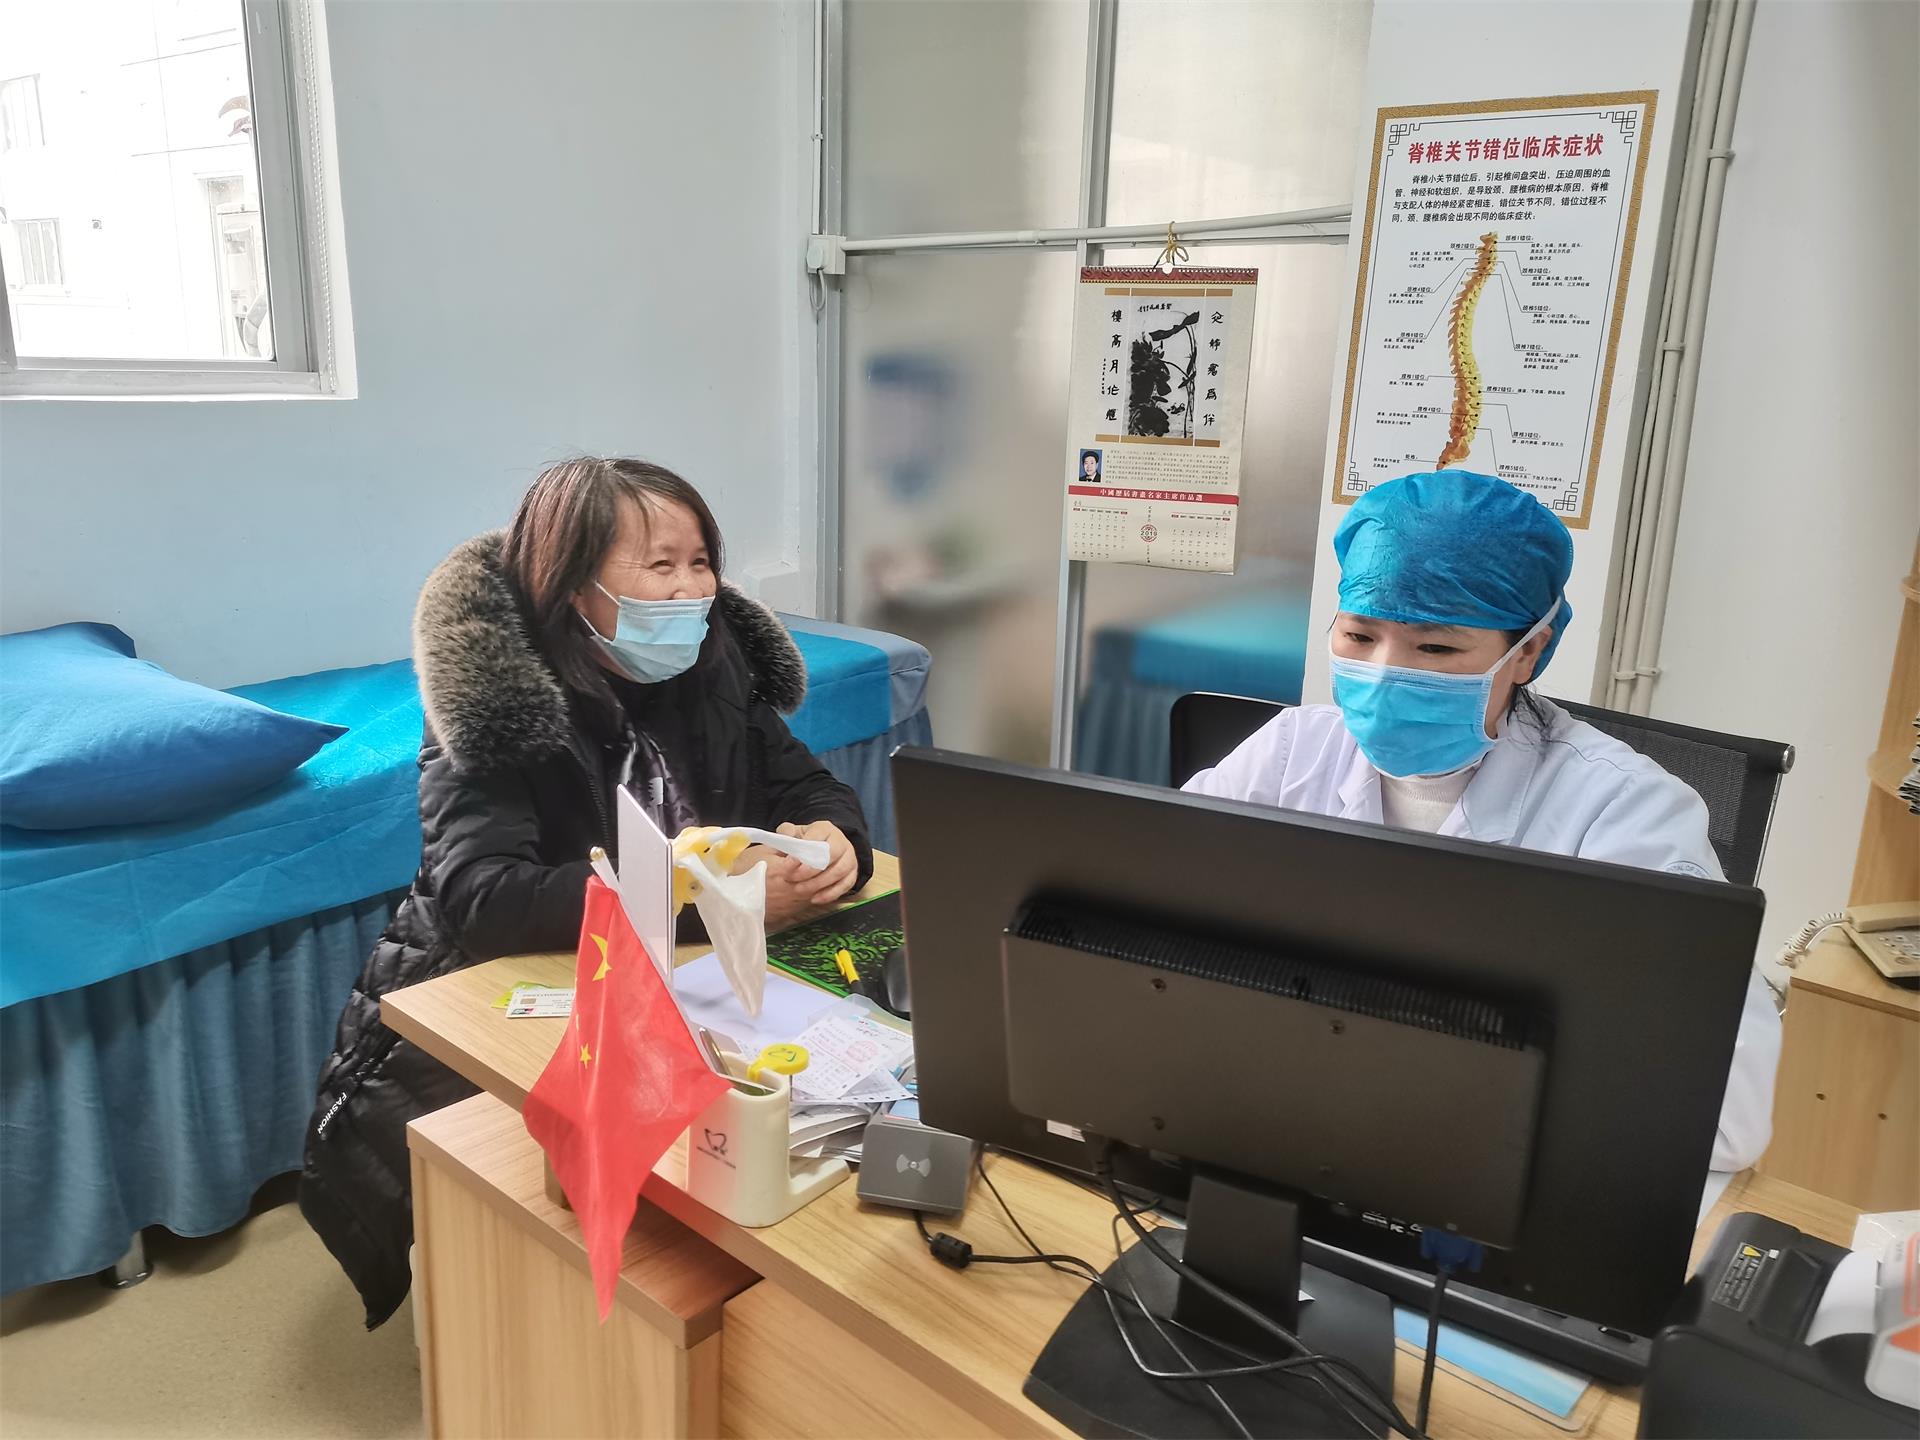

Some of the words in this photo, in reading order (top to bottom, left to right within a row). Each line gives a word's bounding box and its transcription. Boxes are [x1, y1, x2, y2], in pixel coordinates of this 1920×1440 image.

[1408, 133, 1604, 164] 脊椎关节错位临床症状
[317, 1092, 347, 1134] FASHION
